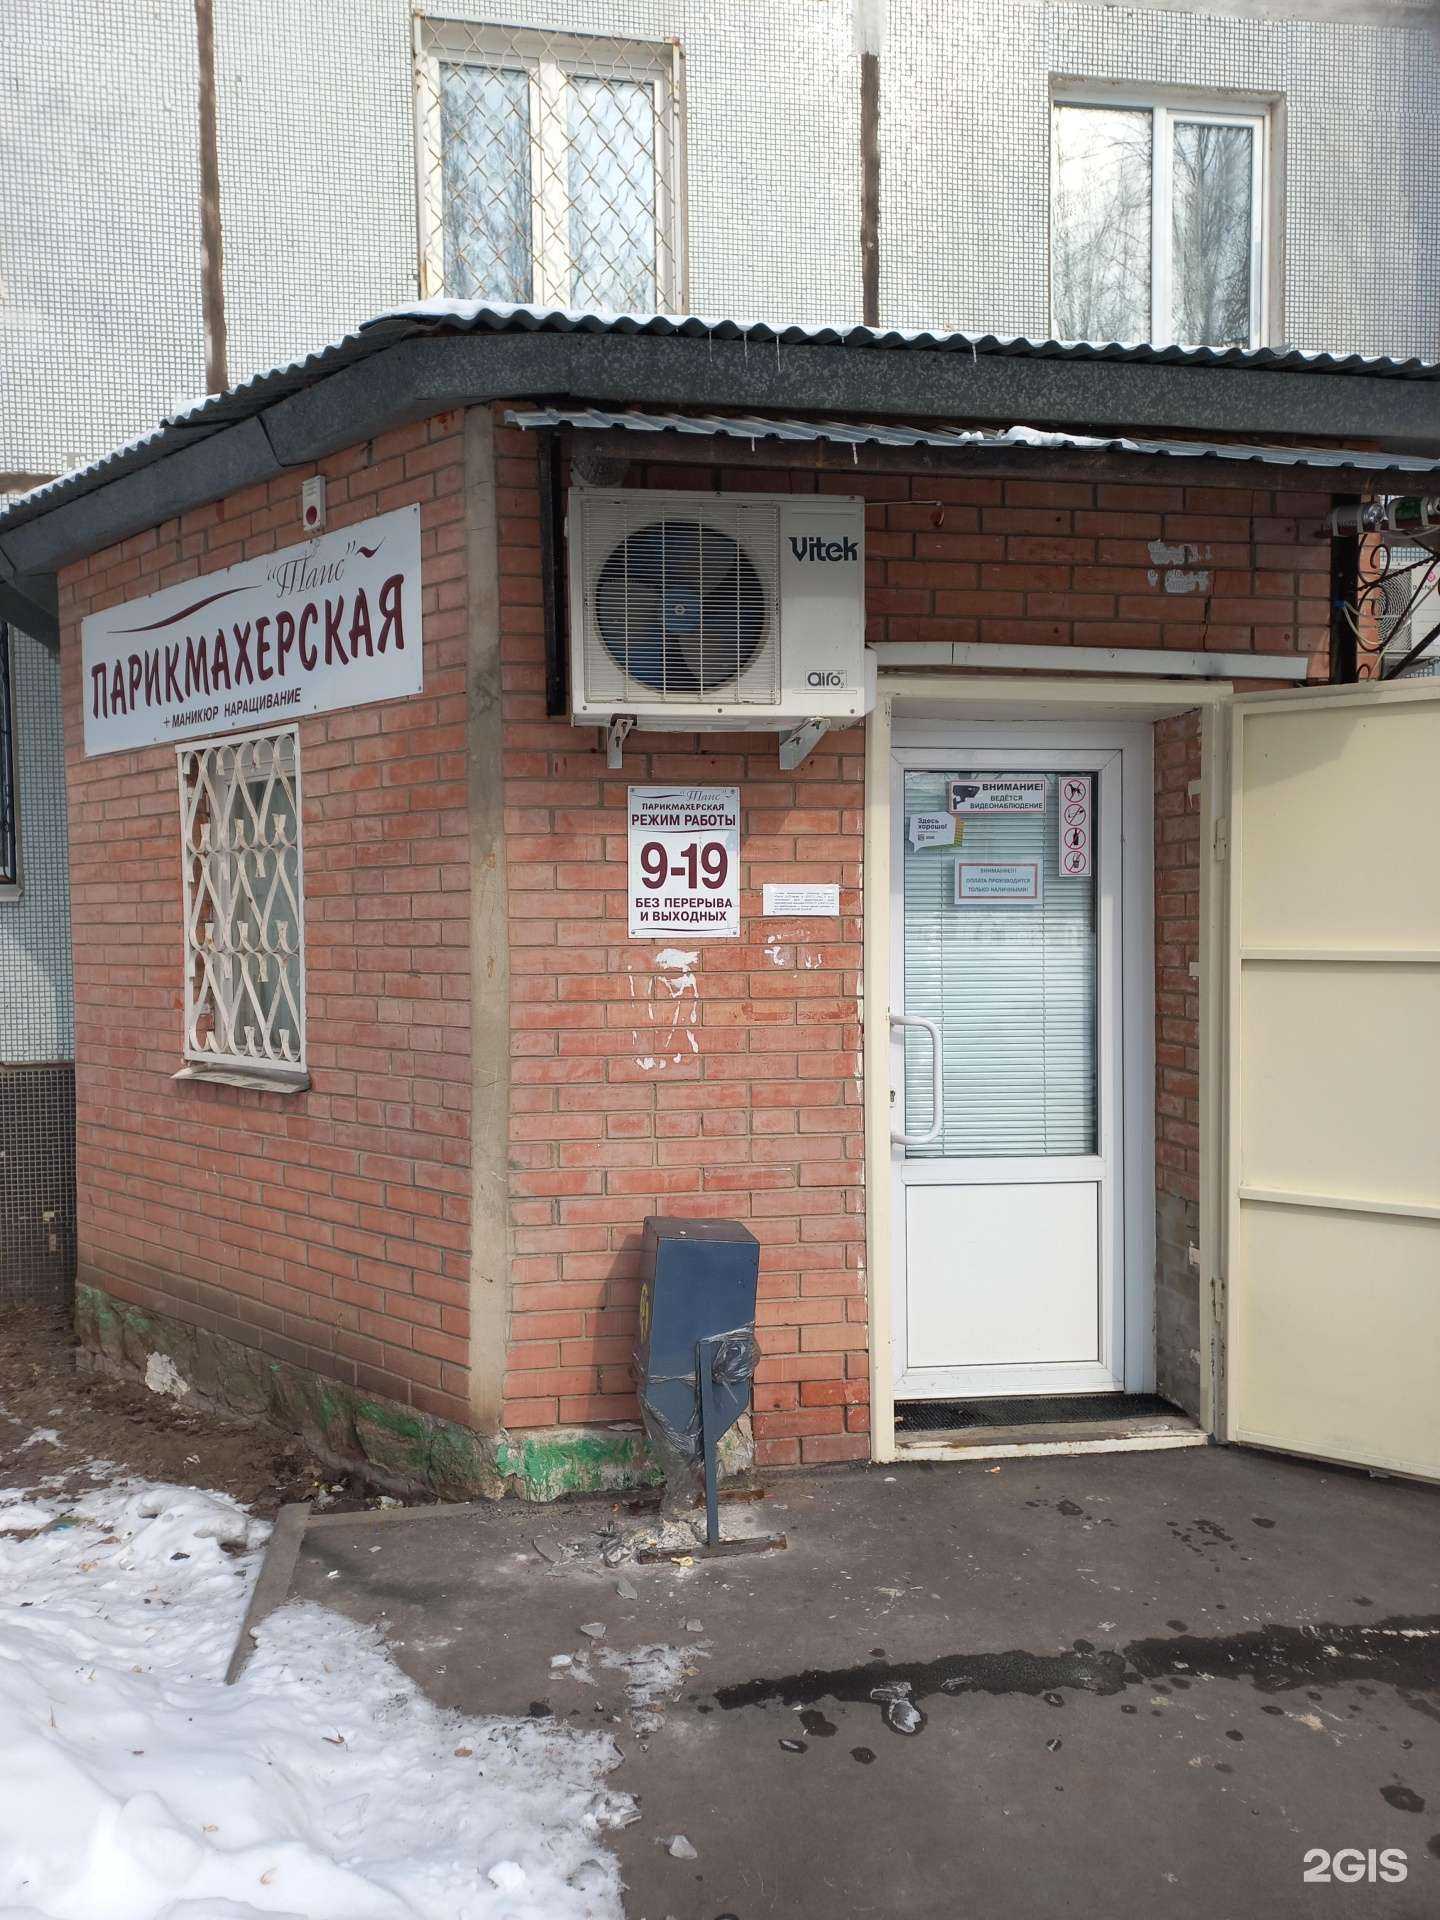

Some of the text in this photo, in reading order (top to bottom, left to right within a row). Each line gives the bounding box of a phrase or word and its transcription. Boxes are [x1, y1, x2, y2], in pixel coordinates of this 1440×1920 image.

[788, 536, 859, 561] Vitek
[91, 573, 405, 719] ПАРИКМАХЕРСКАЯ
[224, 687, 302, 718] НАРАЩИВАНИЕ
[982, 783, 1043, 791] ВНИМАНИЕ!
[642, 803, 724, 811] ПАРИКМАХЕРСКАЯ
[970, 802, 1043, 810] ВИДЕОНАБЛЮДЕНИЕ
[631, 814, 736, 826] РЕЖИМ РАБОТЫ
[641, 842, 728, 889] 9-19
[636, 898, 732, 908] БЕЗ ПЕРЕРЫВА
[640, 911, 727, 923] И ВЫХОДНЫХ
